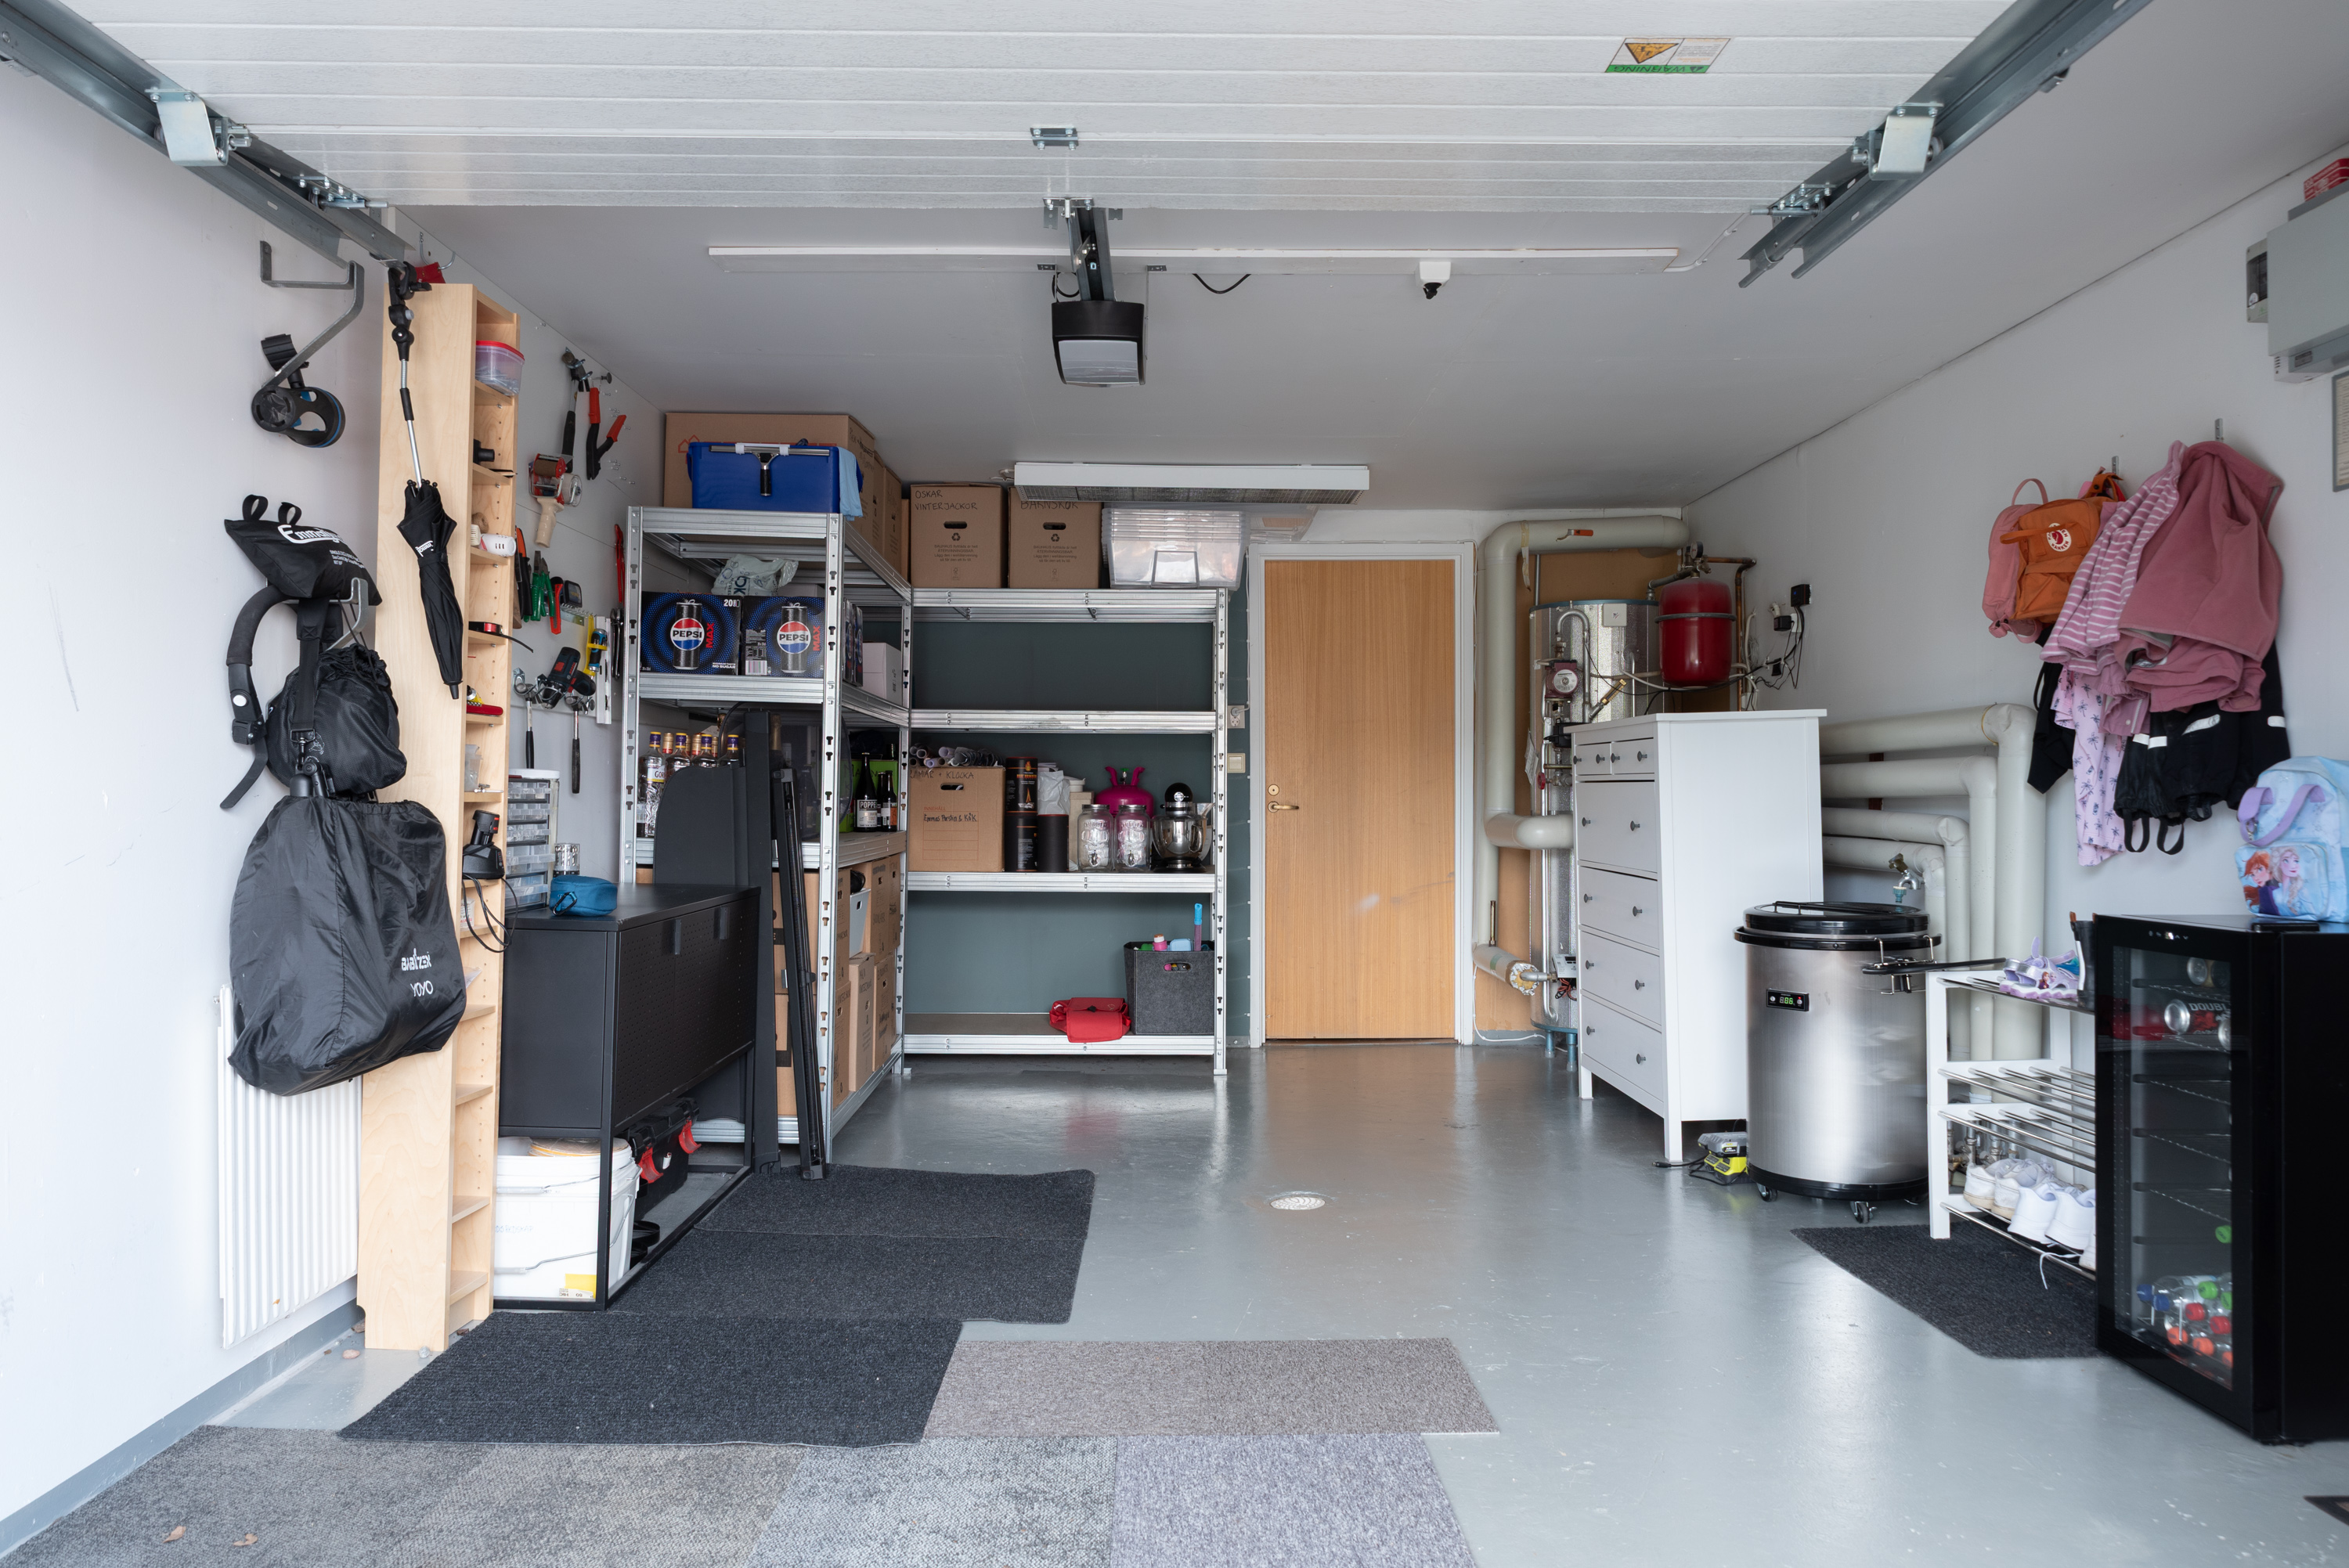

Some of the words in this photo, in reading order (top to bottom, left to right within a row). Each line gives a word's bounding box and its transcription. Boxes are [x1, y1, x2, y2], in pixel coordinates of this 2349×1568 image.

[915, 490, 943, 499] OSKAR
[723, 599, 733, 607] 20
[673, 630, 702, 639] PEPSI
[705, 622, 715, 648] MAX
[410, 980, 434, 997] YOYO
